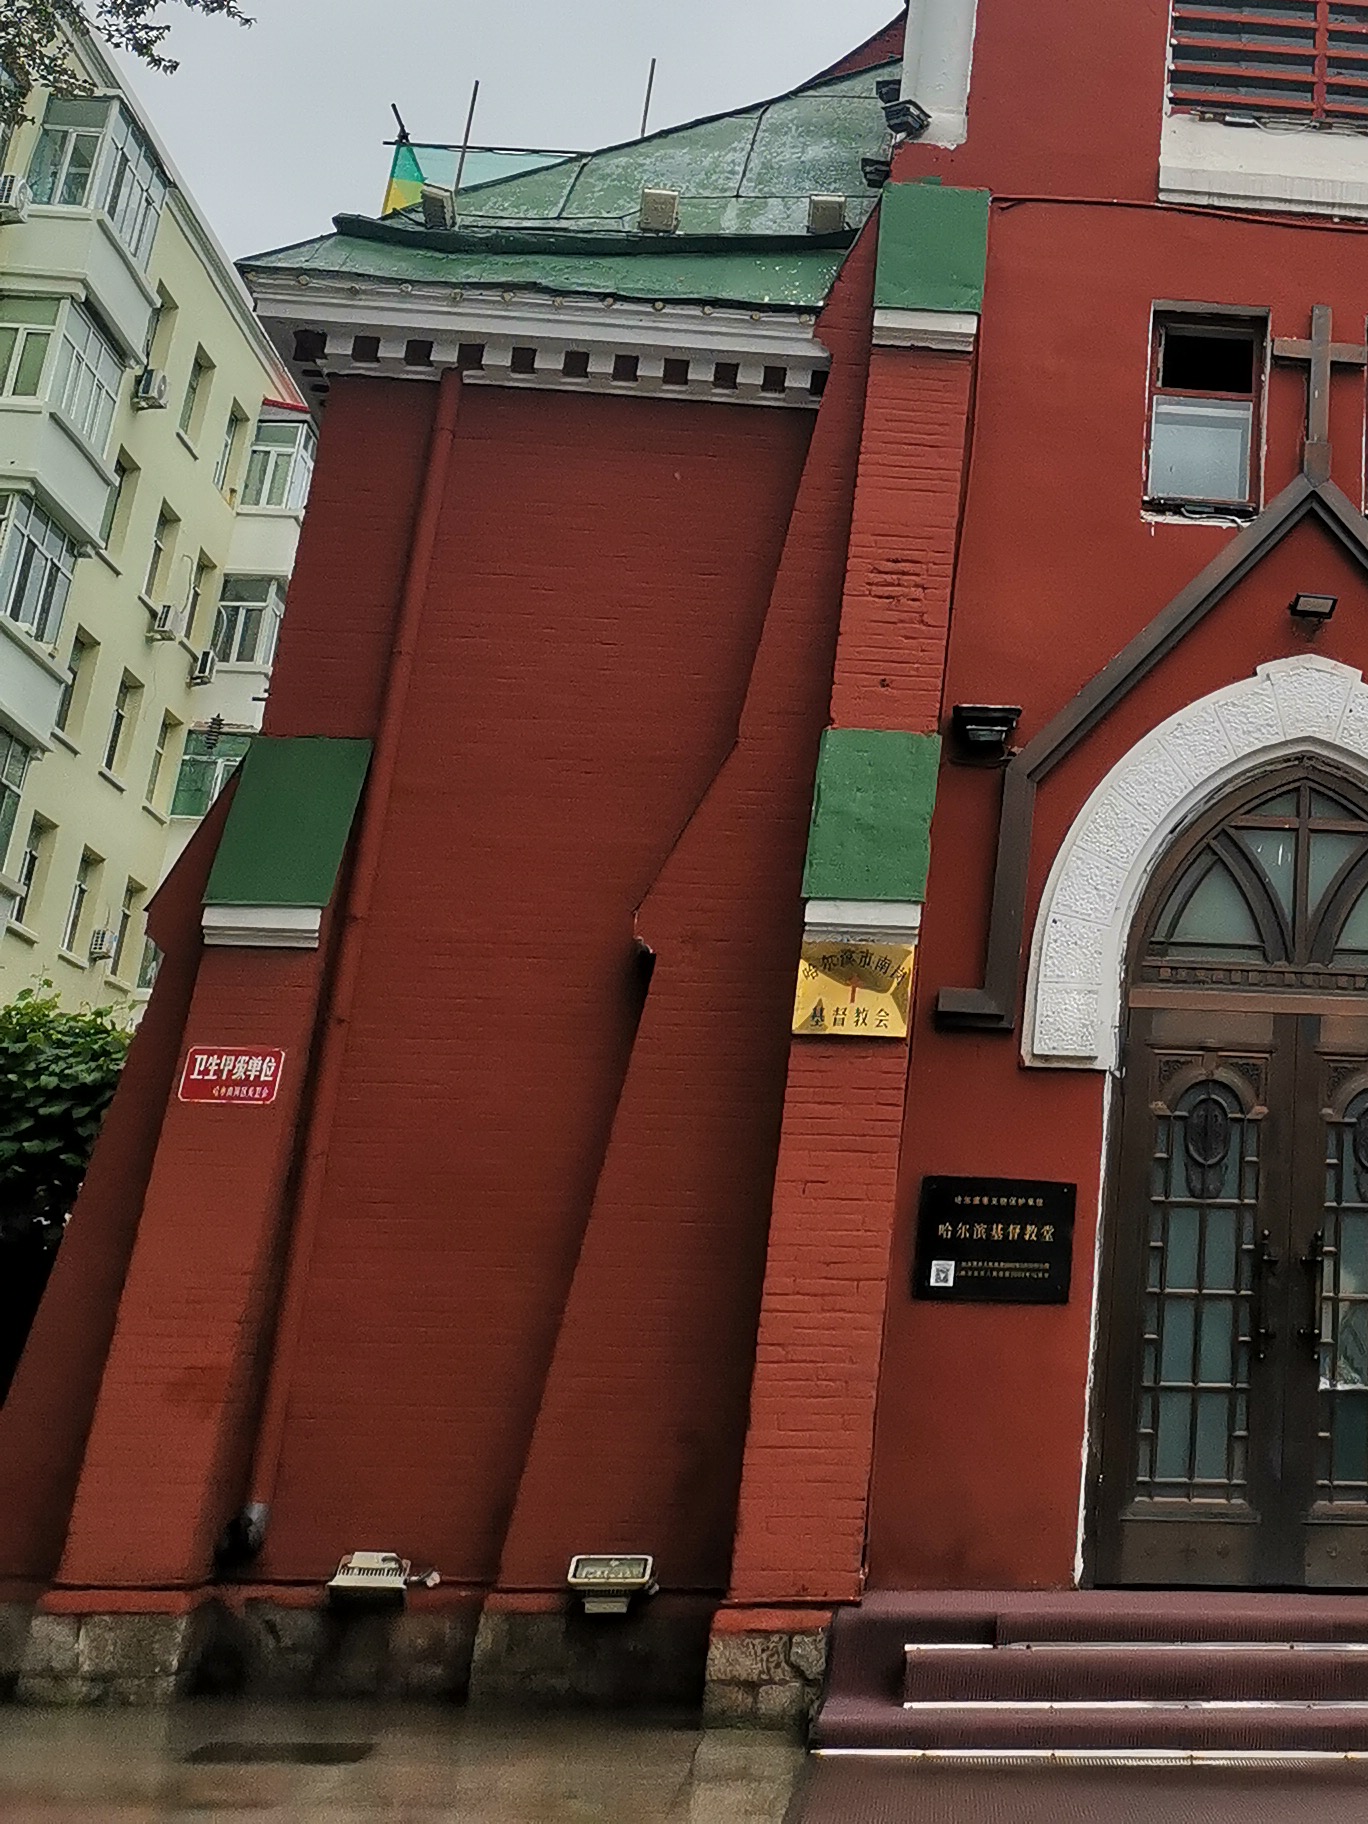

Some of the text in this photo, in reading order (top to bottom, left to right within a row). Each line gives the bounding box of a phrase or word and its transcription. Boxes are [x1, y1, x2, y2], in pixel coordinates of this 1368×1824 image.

[810, 1006, 890, 1029] 基督教会
[190, 1054, 276, 1082] 卫生甲级单位
[938, 1222, 1055, 1242] 哈尔滨基督教堂
